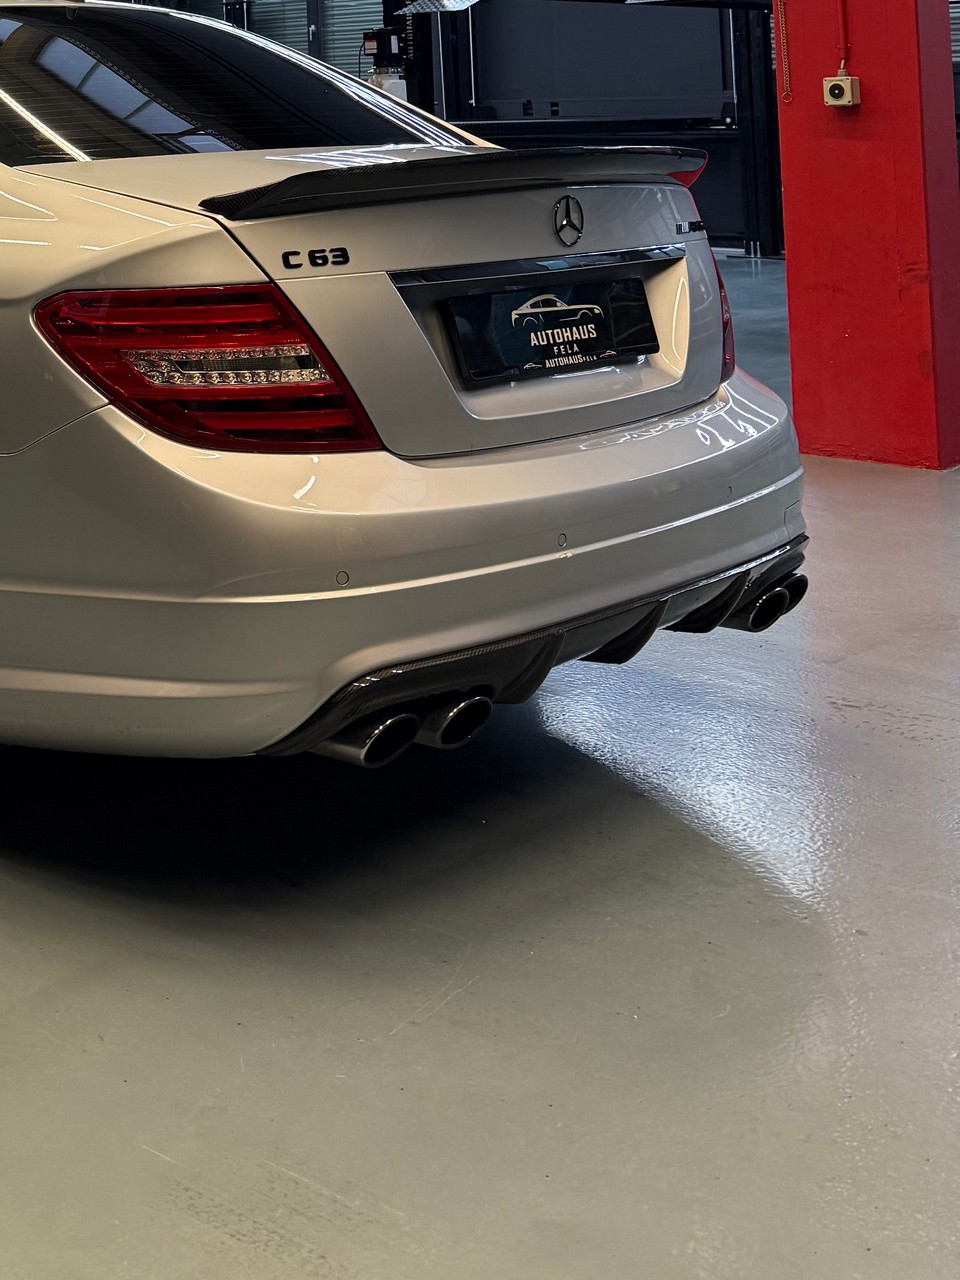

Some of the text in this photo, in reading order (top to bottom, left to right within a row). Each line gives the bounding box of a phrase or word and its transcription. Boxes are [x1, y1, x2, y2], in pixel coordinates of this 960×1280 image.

[281, 247, 350, 269] C 63
[529, 323, 597, 347] AUTOHAUS
[553, 343, 580, 355] FELA
